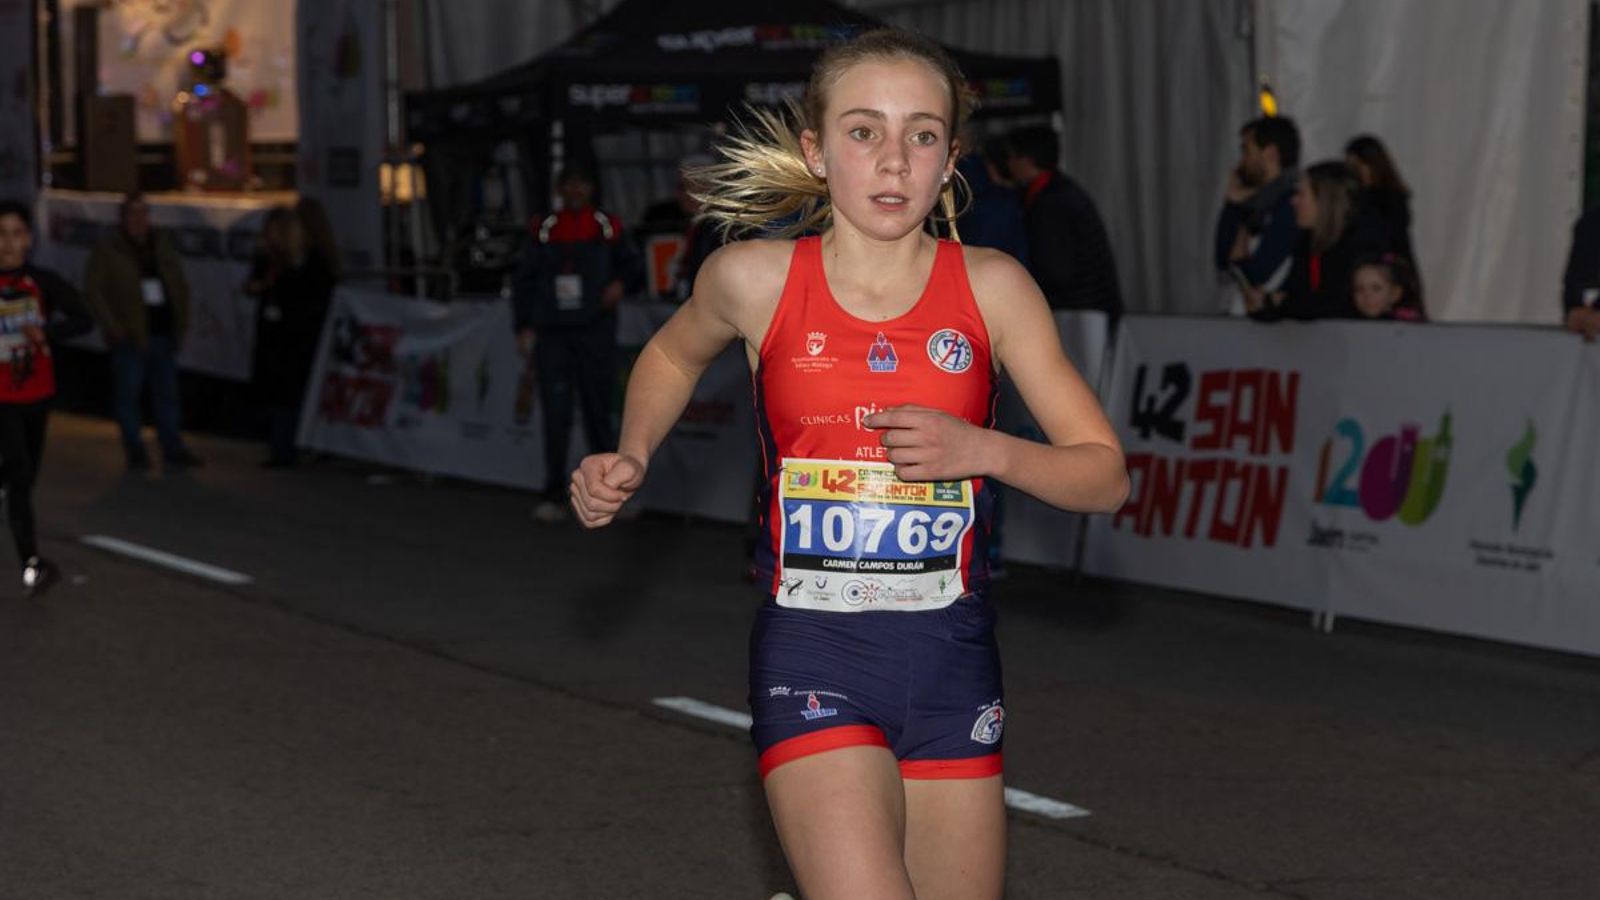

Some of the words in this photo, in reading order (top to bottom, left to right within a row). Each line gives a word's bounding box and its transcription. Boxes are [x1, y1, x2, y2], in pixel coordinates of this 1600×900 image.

[800, 414, 851, 425] CLINICAS
[1129, 361, 1191, 444] 42
[1191, 367, 1300, 455] SAN
[822, 468, 857, 493] 42
[1112, 453, 1289, 550] ANTON
[788, 504, 964, 555] 10769
[823, 559, 857, 569] CARMEN
[858, 561, 895, 570] CAMPOS
[896, 561, 925, 570] DURÁN
